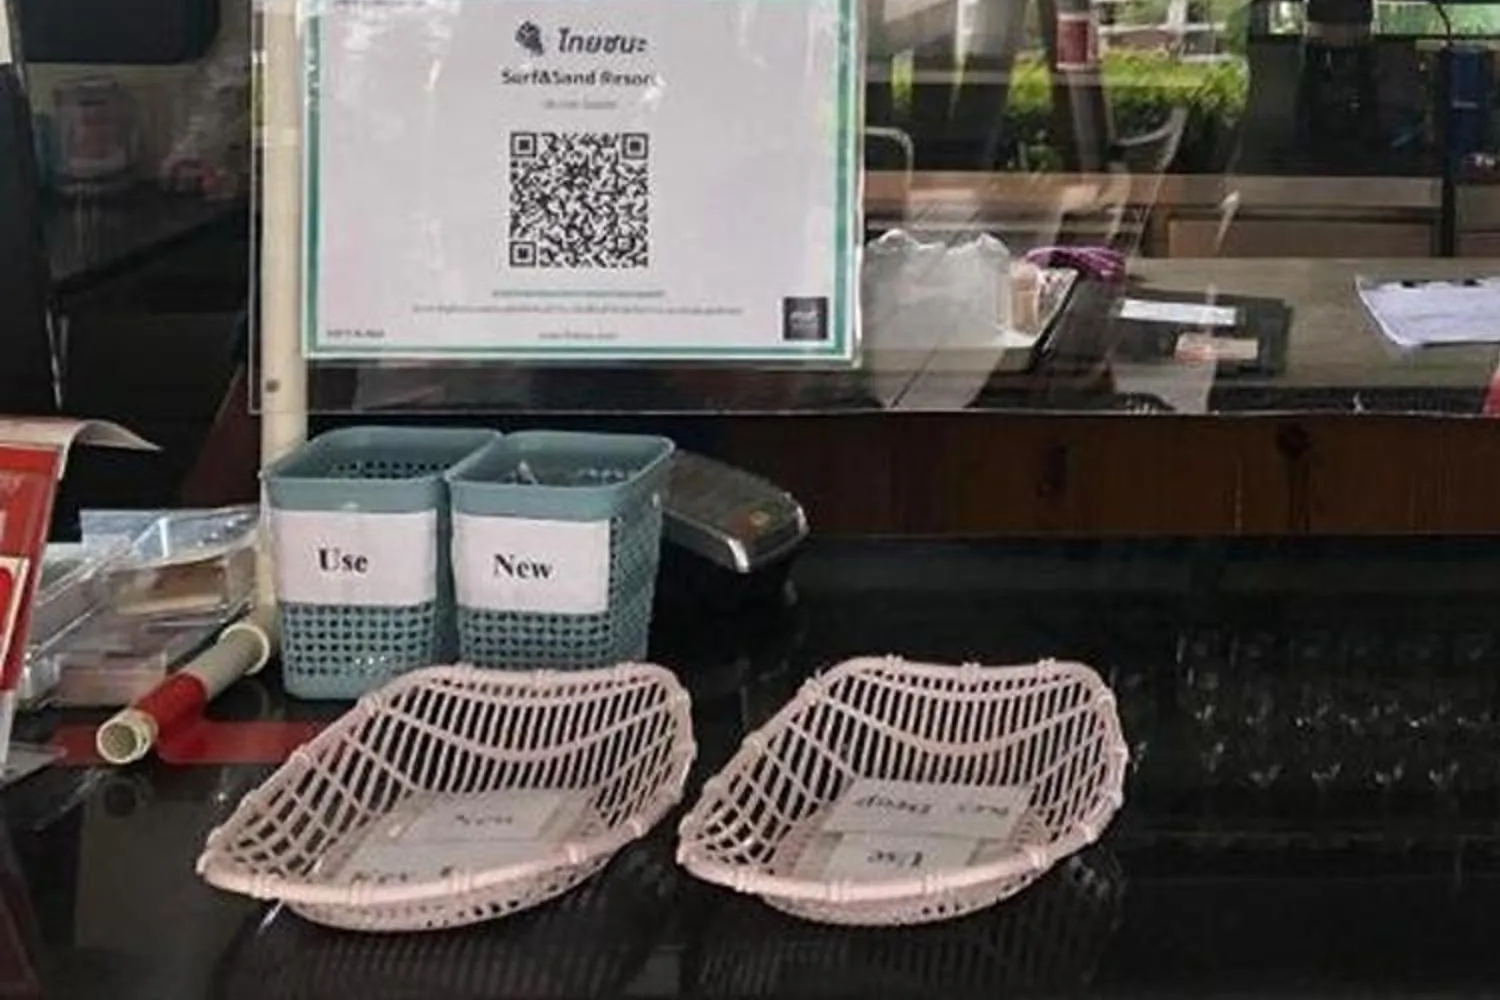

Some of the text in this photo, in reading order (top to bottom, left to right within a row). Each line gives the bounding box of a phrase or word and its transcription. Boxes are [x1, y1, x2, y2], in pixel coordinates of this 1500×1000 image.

[557, 27, 648, 55] ไทยชนะ
[500, 69, 656, 86] Surf&Sand Resor
[317, 547, 369, 574] Use
[493, 552, 554, 580] New
